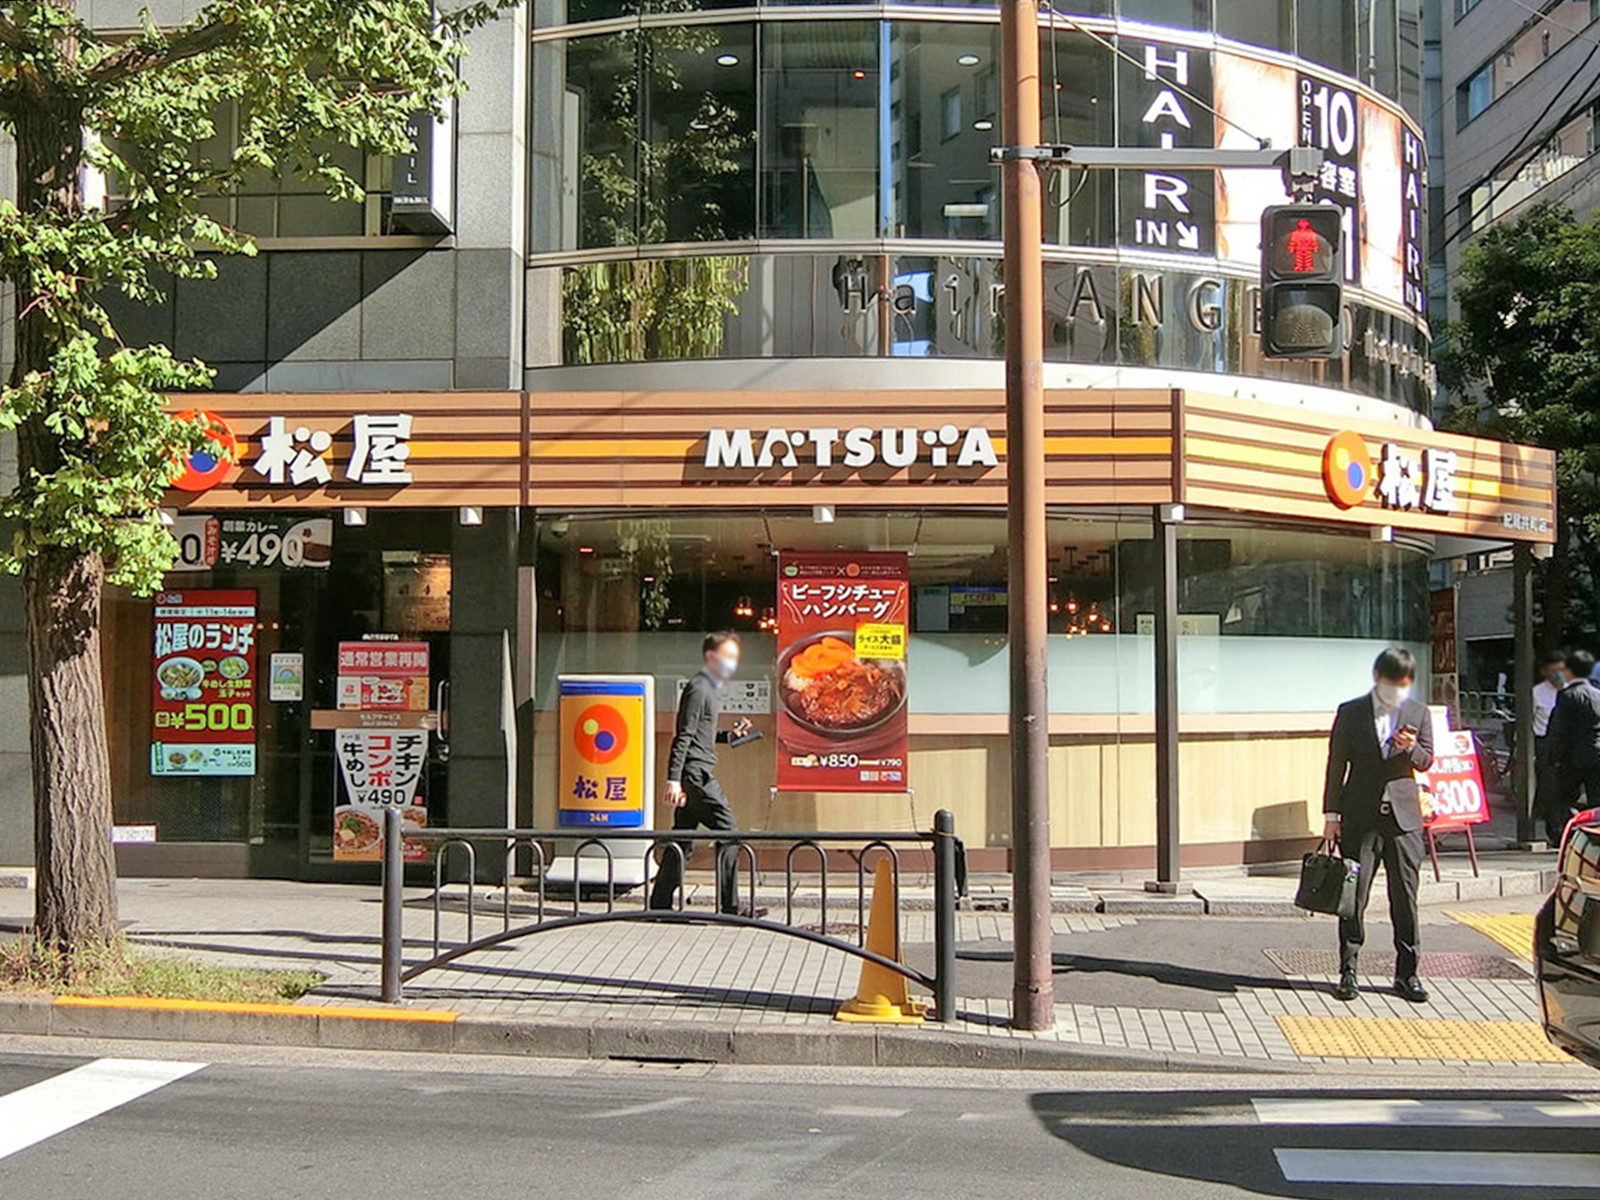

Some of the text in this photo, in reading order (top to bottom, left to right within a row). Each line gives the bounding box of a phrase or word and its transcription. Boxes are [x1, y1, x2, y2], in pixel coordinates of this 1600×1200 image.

[1142, 45, 1192, 213] HAIR
[1313, 86, 1355, 156] 10
[406, 126, 418, 184] NAIL
[1404, 131, 1421, 281] HAIR
[1134, 218, 1168, 246] IN
[842, 273, 1006, 317] Hair
[253, 413, 414, 486] 松屋
[703, 424, 999, 468] MATSUYA
[1376, 442, 1460, 513] 松屋
[220, 532, 304, 568] ¥490
[792, 583, 896, 601] ビーフシチュー
[802, 600, 891, 619] ハンバーグ
[154, 622, 255, 659] 松屋のランチ
[340, 650, 428, 668] 通常営業再開
[170, 703, 253, 731] ¥500
[342, 742, 367, 788] 牛めし
[367, 734, 394, 788] コンボ
[394, 734, 423, 788] チキン
[819, 754, 859, 768] ¥850
[357, 788, 406, 804] ¥490
[572, 775, 628, 801] 松屋
